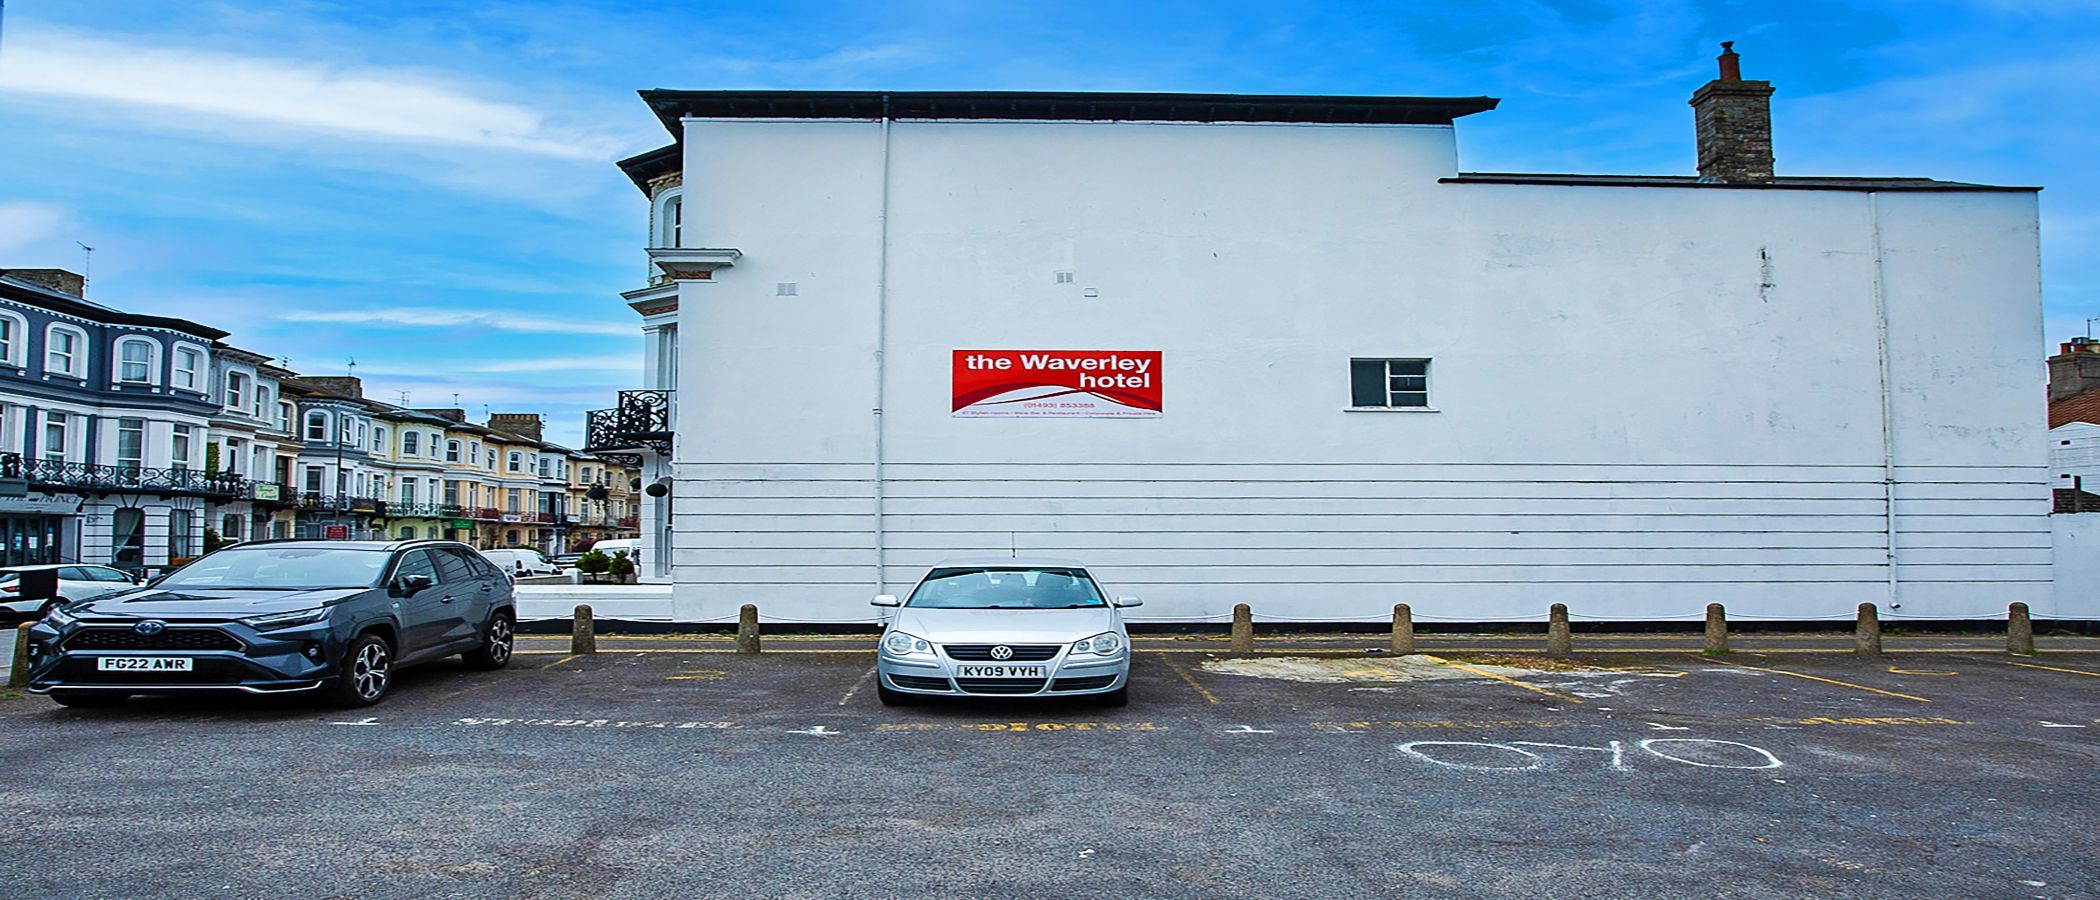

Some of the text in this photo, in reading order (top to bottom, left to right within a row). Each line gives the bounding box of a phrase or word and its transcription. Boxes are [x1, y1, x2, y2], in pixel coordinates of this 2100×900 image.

[965, 354, 1151, 373] the Waverley
[1079, 372, 1150, 388] hotel
[105, 658, 185, 669] FG22 AWR
[963, 666, 1038, 676] KY09 VYH
